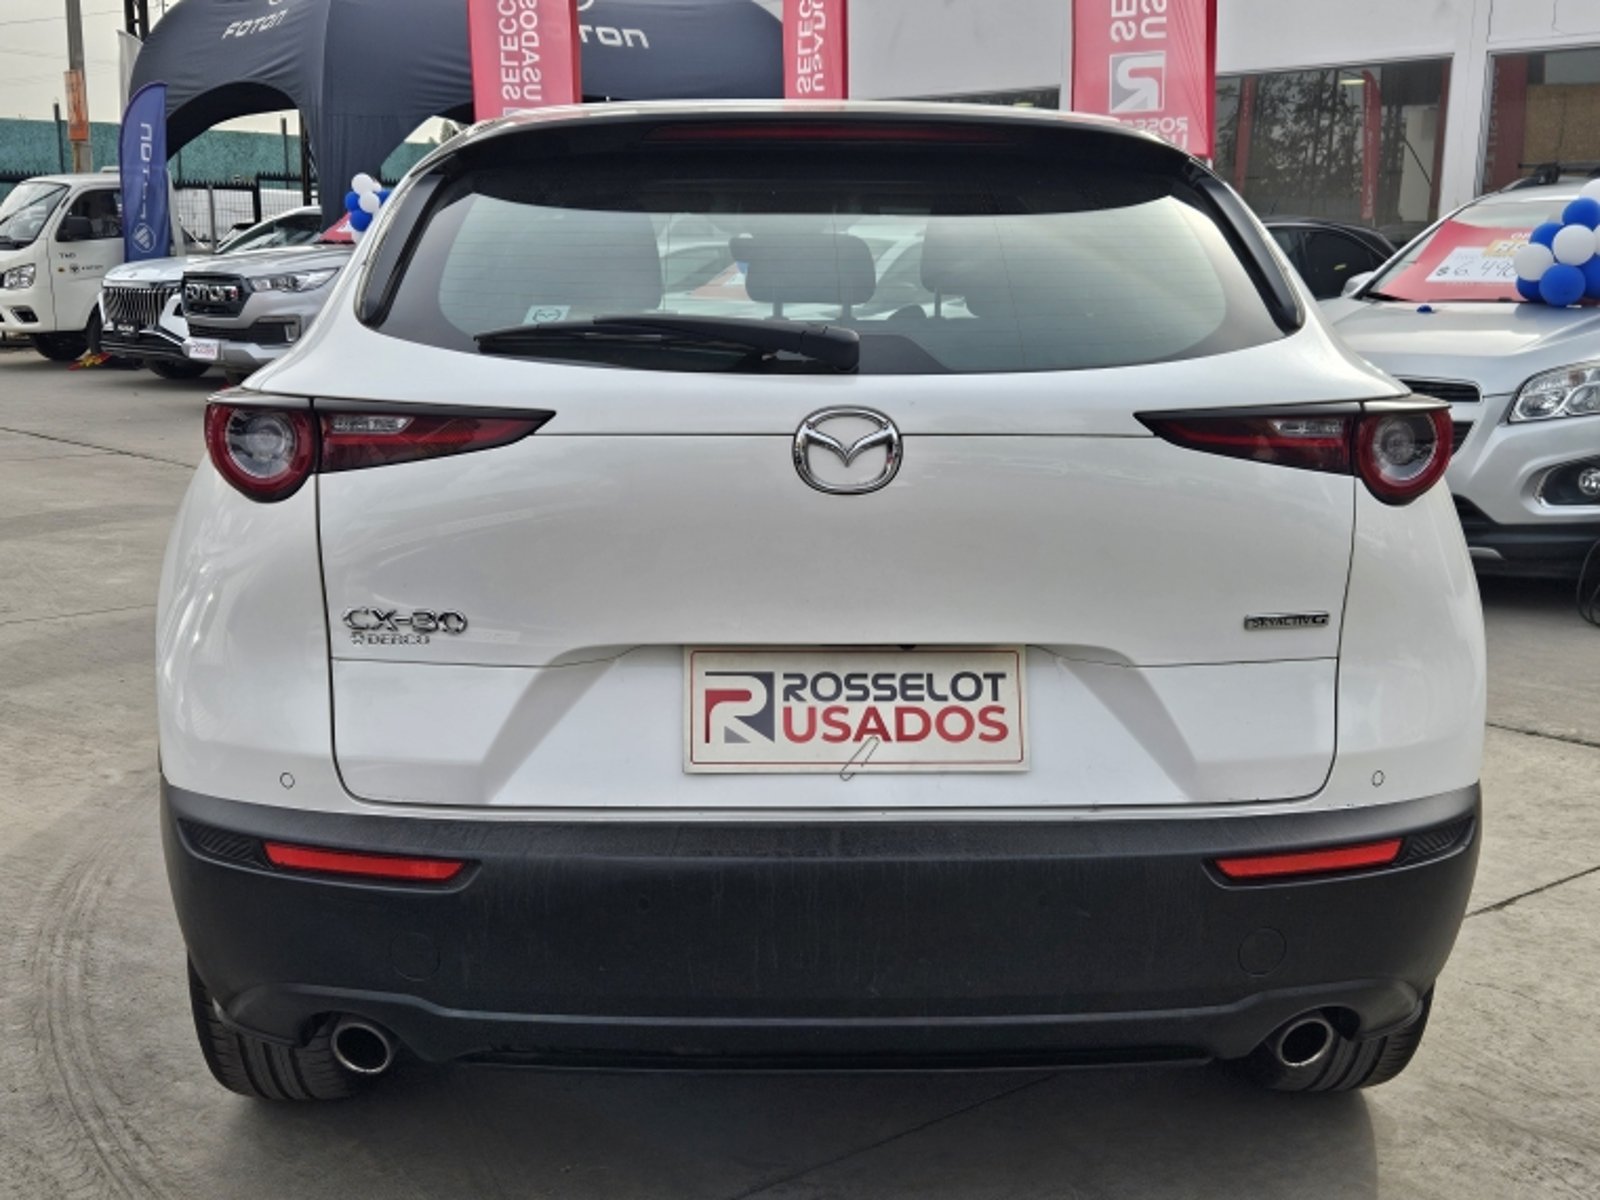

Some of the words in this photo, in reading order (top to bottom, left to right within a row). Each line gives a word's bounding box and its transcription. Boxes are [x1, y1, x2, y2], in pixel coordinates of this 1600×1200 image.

[342, 607, 468, 635] CX-30
[366, 633, 431, 645] DERCO
[782, 672, 1007, 702] ROSSELOT
[782, 705, 1009, 744] USADOS
